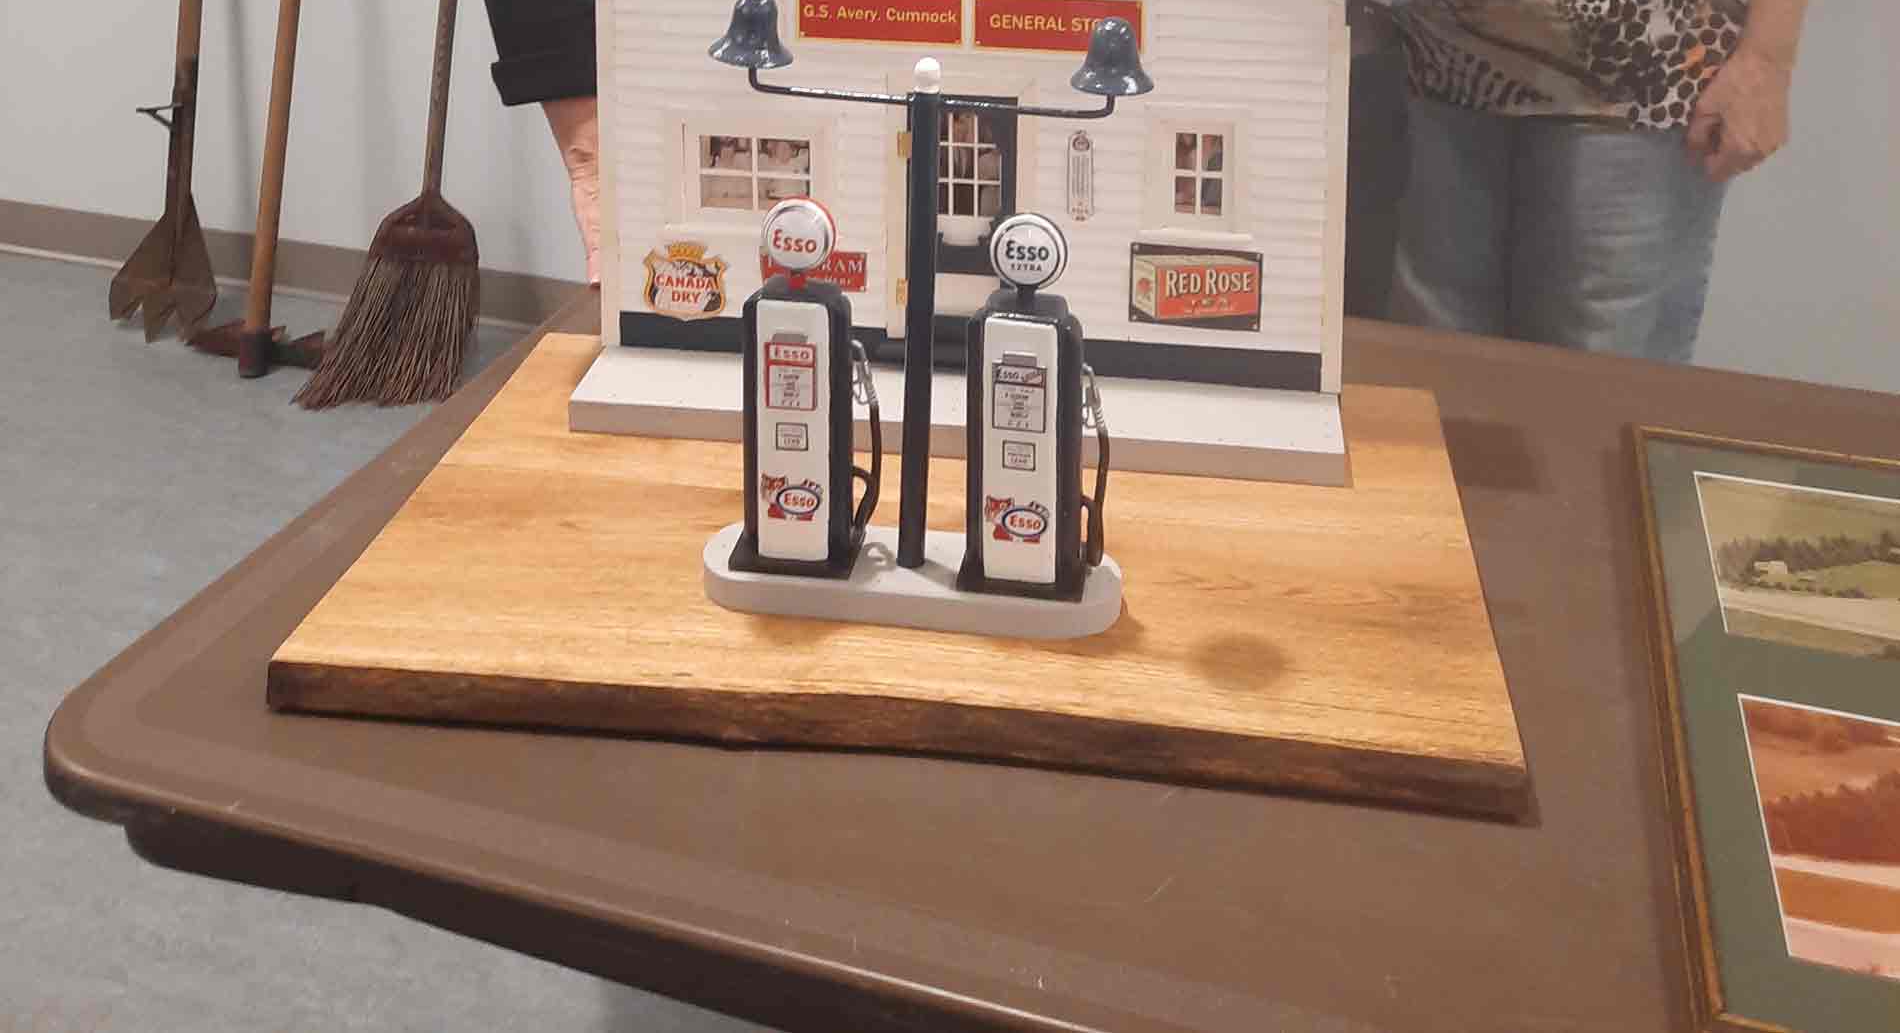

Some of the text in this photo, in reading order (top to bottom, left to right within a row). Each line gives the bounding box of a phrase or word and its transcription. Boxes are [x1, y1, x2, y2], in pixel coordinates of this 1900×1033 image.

[886, 7, 957, 24] Cumnock
[990, 14, 1066, 32] GENERAL
[655, 273, 716, 290] CANADA
[671, 290, 702, 303] DRY
